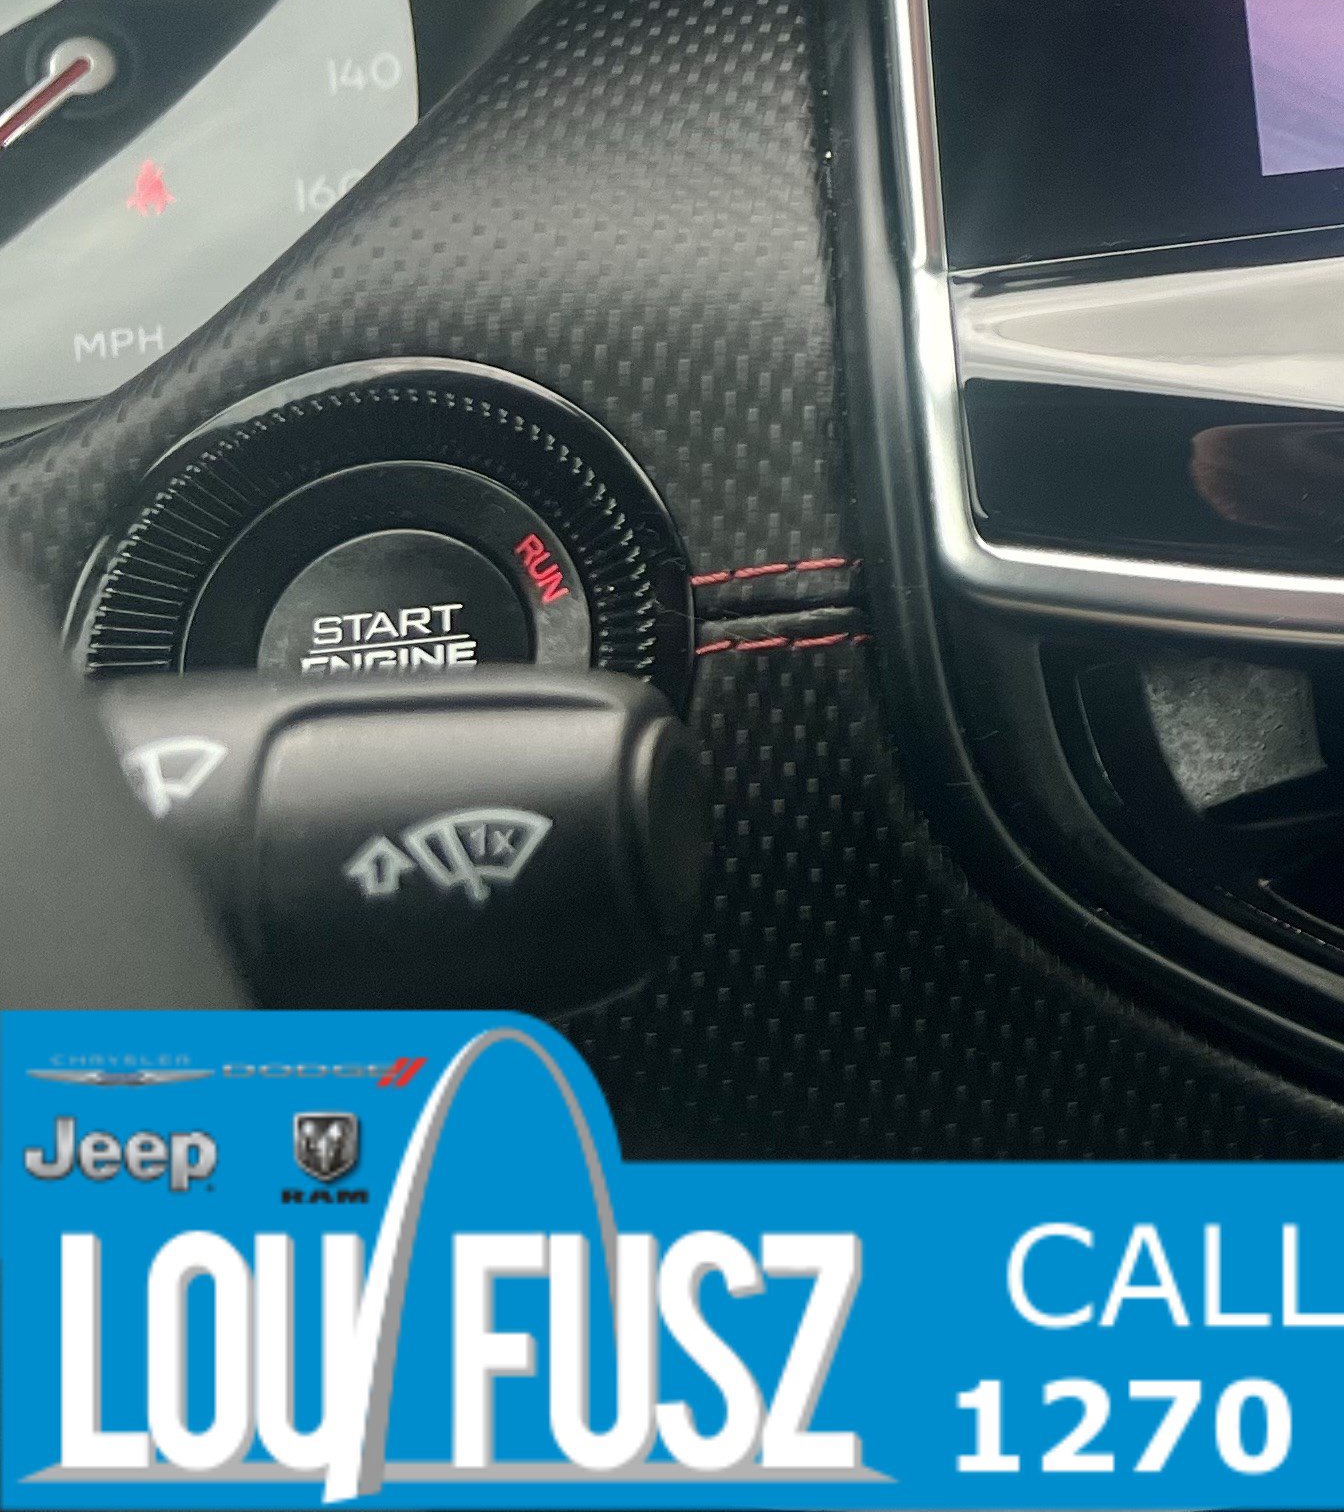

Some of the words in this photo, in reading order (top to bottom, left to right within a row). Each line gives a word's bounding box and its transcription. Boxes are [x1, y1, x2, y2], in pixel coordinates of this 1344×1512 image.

[326, 52, 401, 93] 140
[74, 325, 165, 364] MPH
[513, 533, 570, 605] RUN
[311, 602, 464, 646] START
